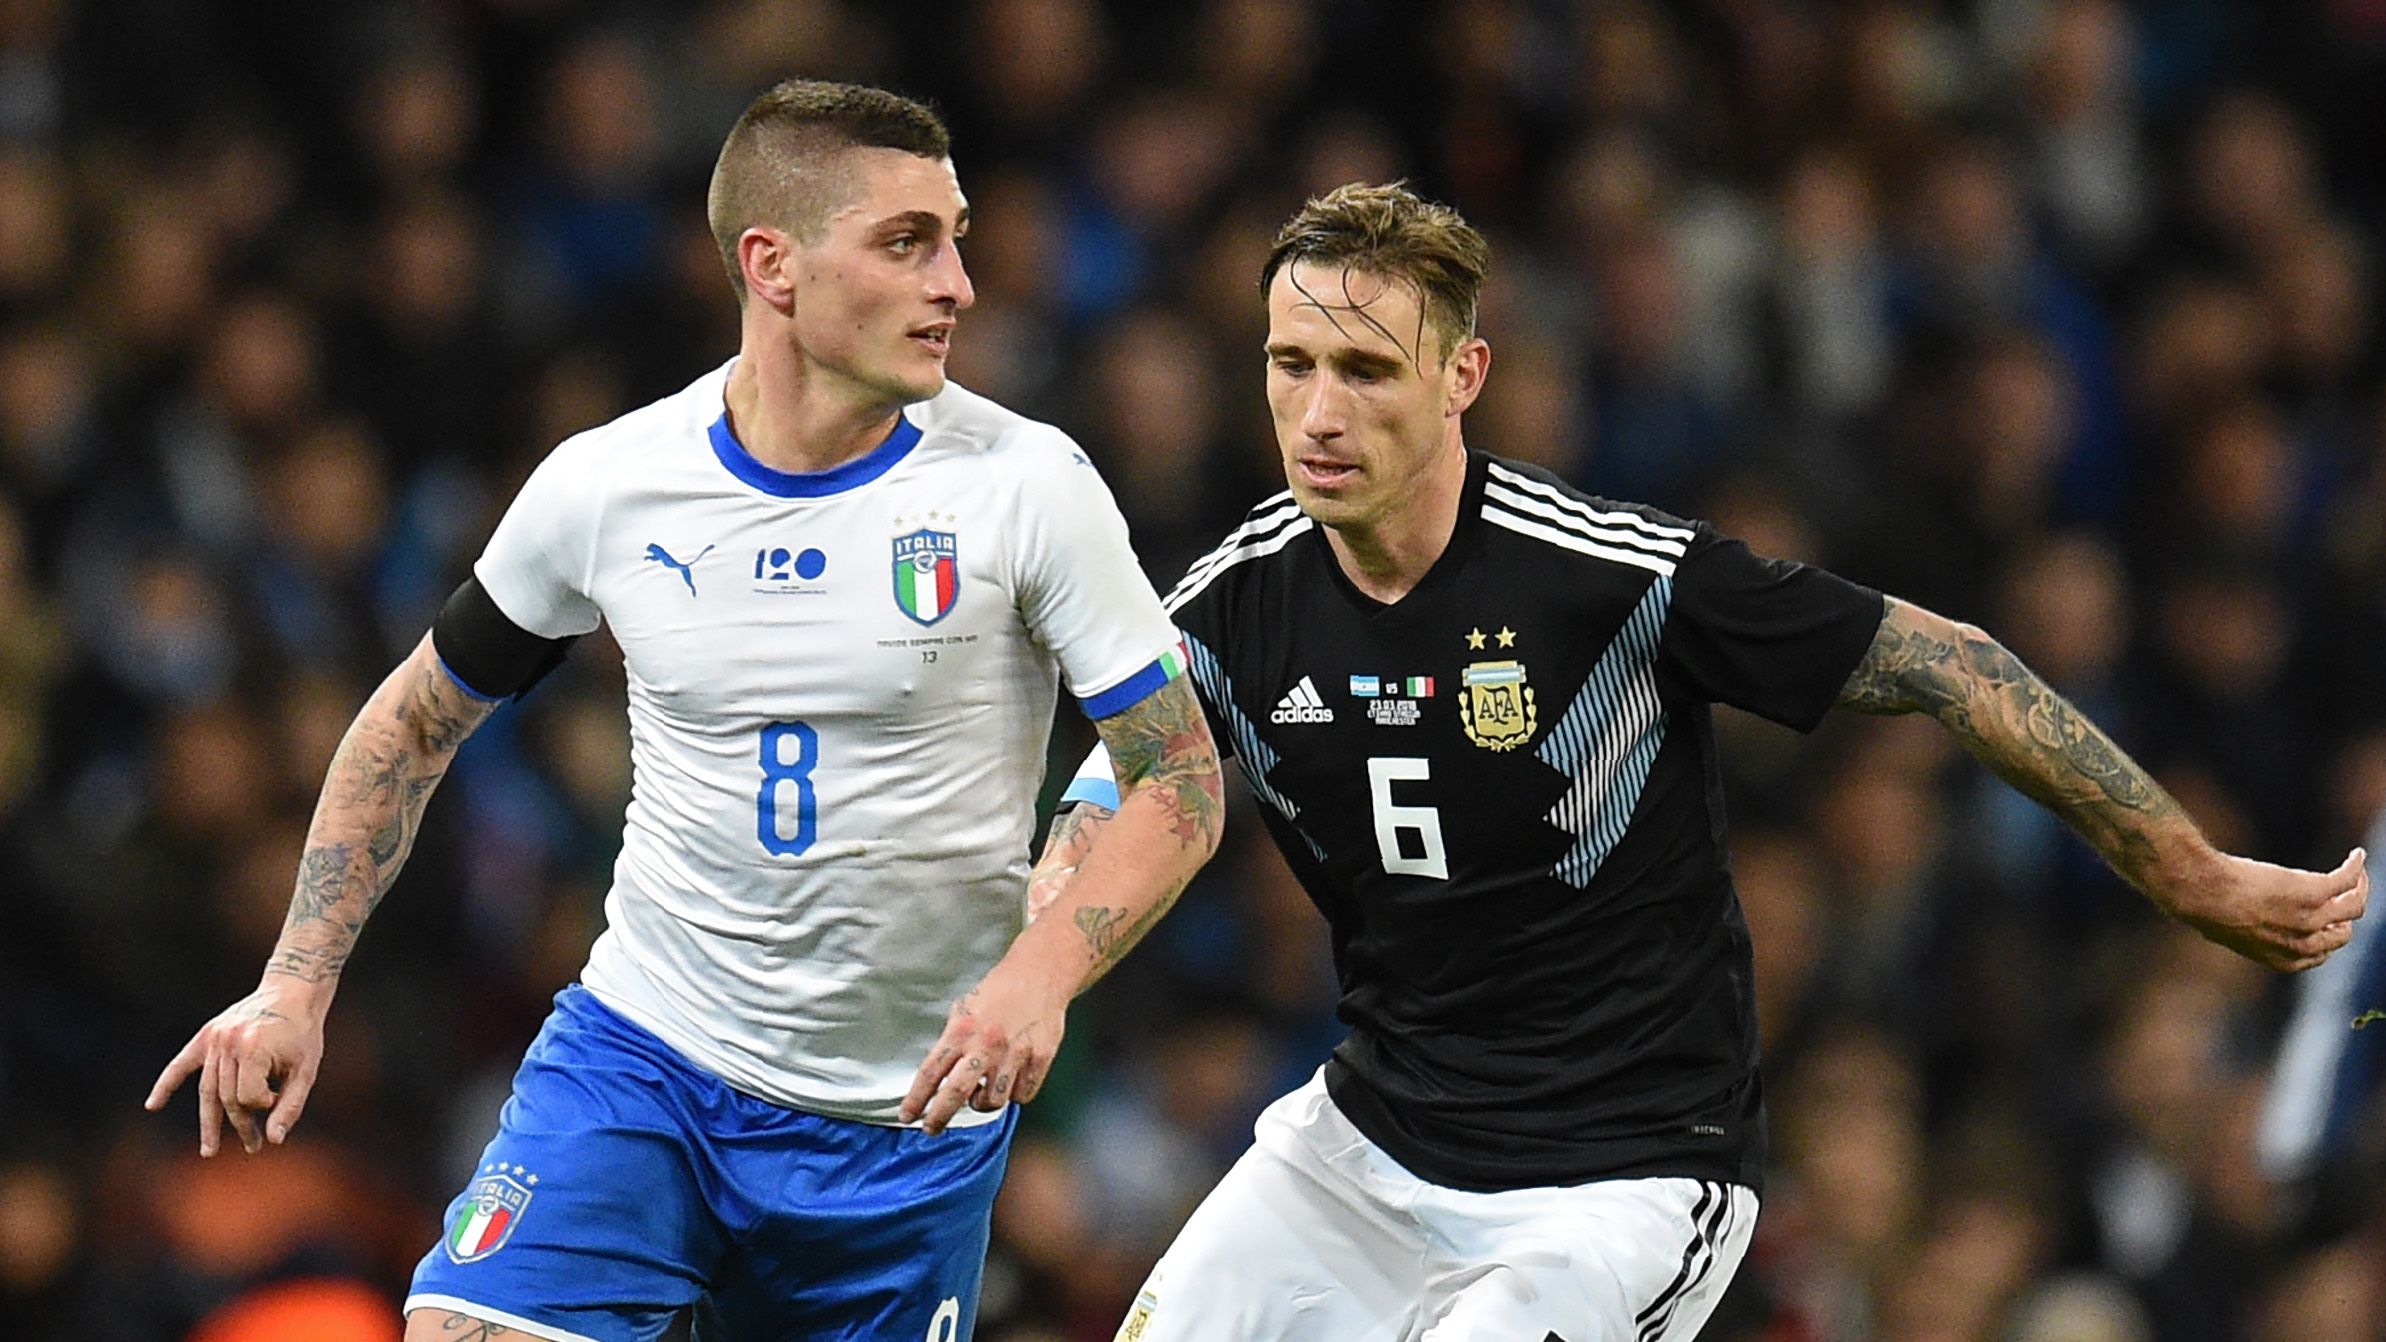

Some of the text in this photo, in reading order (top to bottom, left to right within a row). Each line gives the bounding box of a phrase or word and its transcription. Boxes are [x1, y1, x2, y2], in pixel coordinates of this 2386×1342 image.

[896, 534, 954, 554] ITALIA
[921, 650, 938, 664] 13
[1270, 705, 1334, 724] adidas
[1478, 685, 1519, 725] AFA
[757, 720, 818, 857] 8
[1367, 757, 1449, 880] 6
